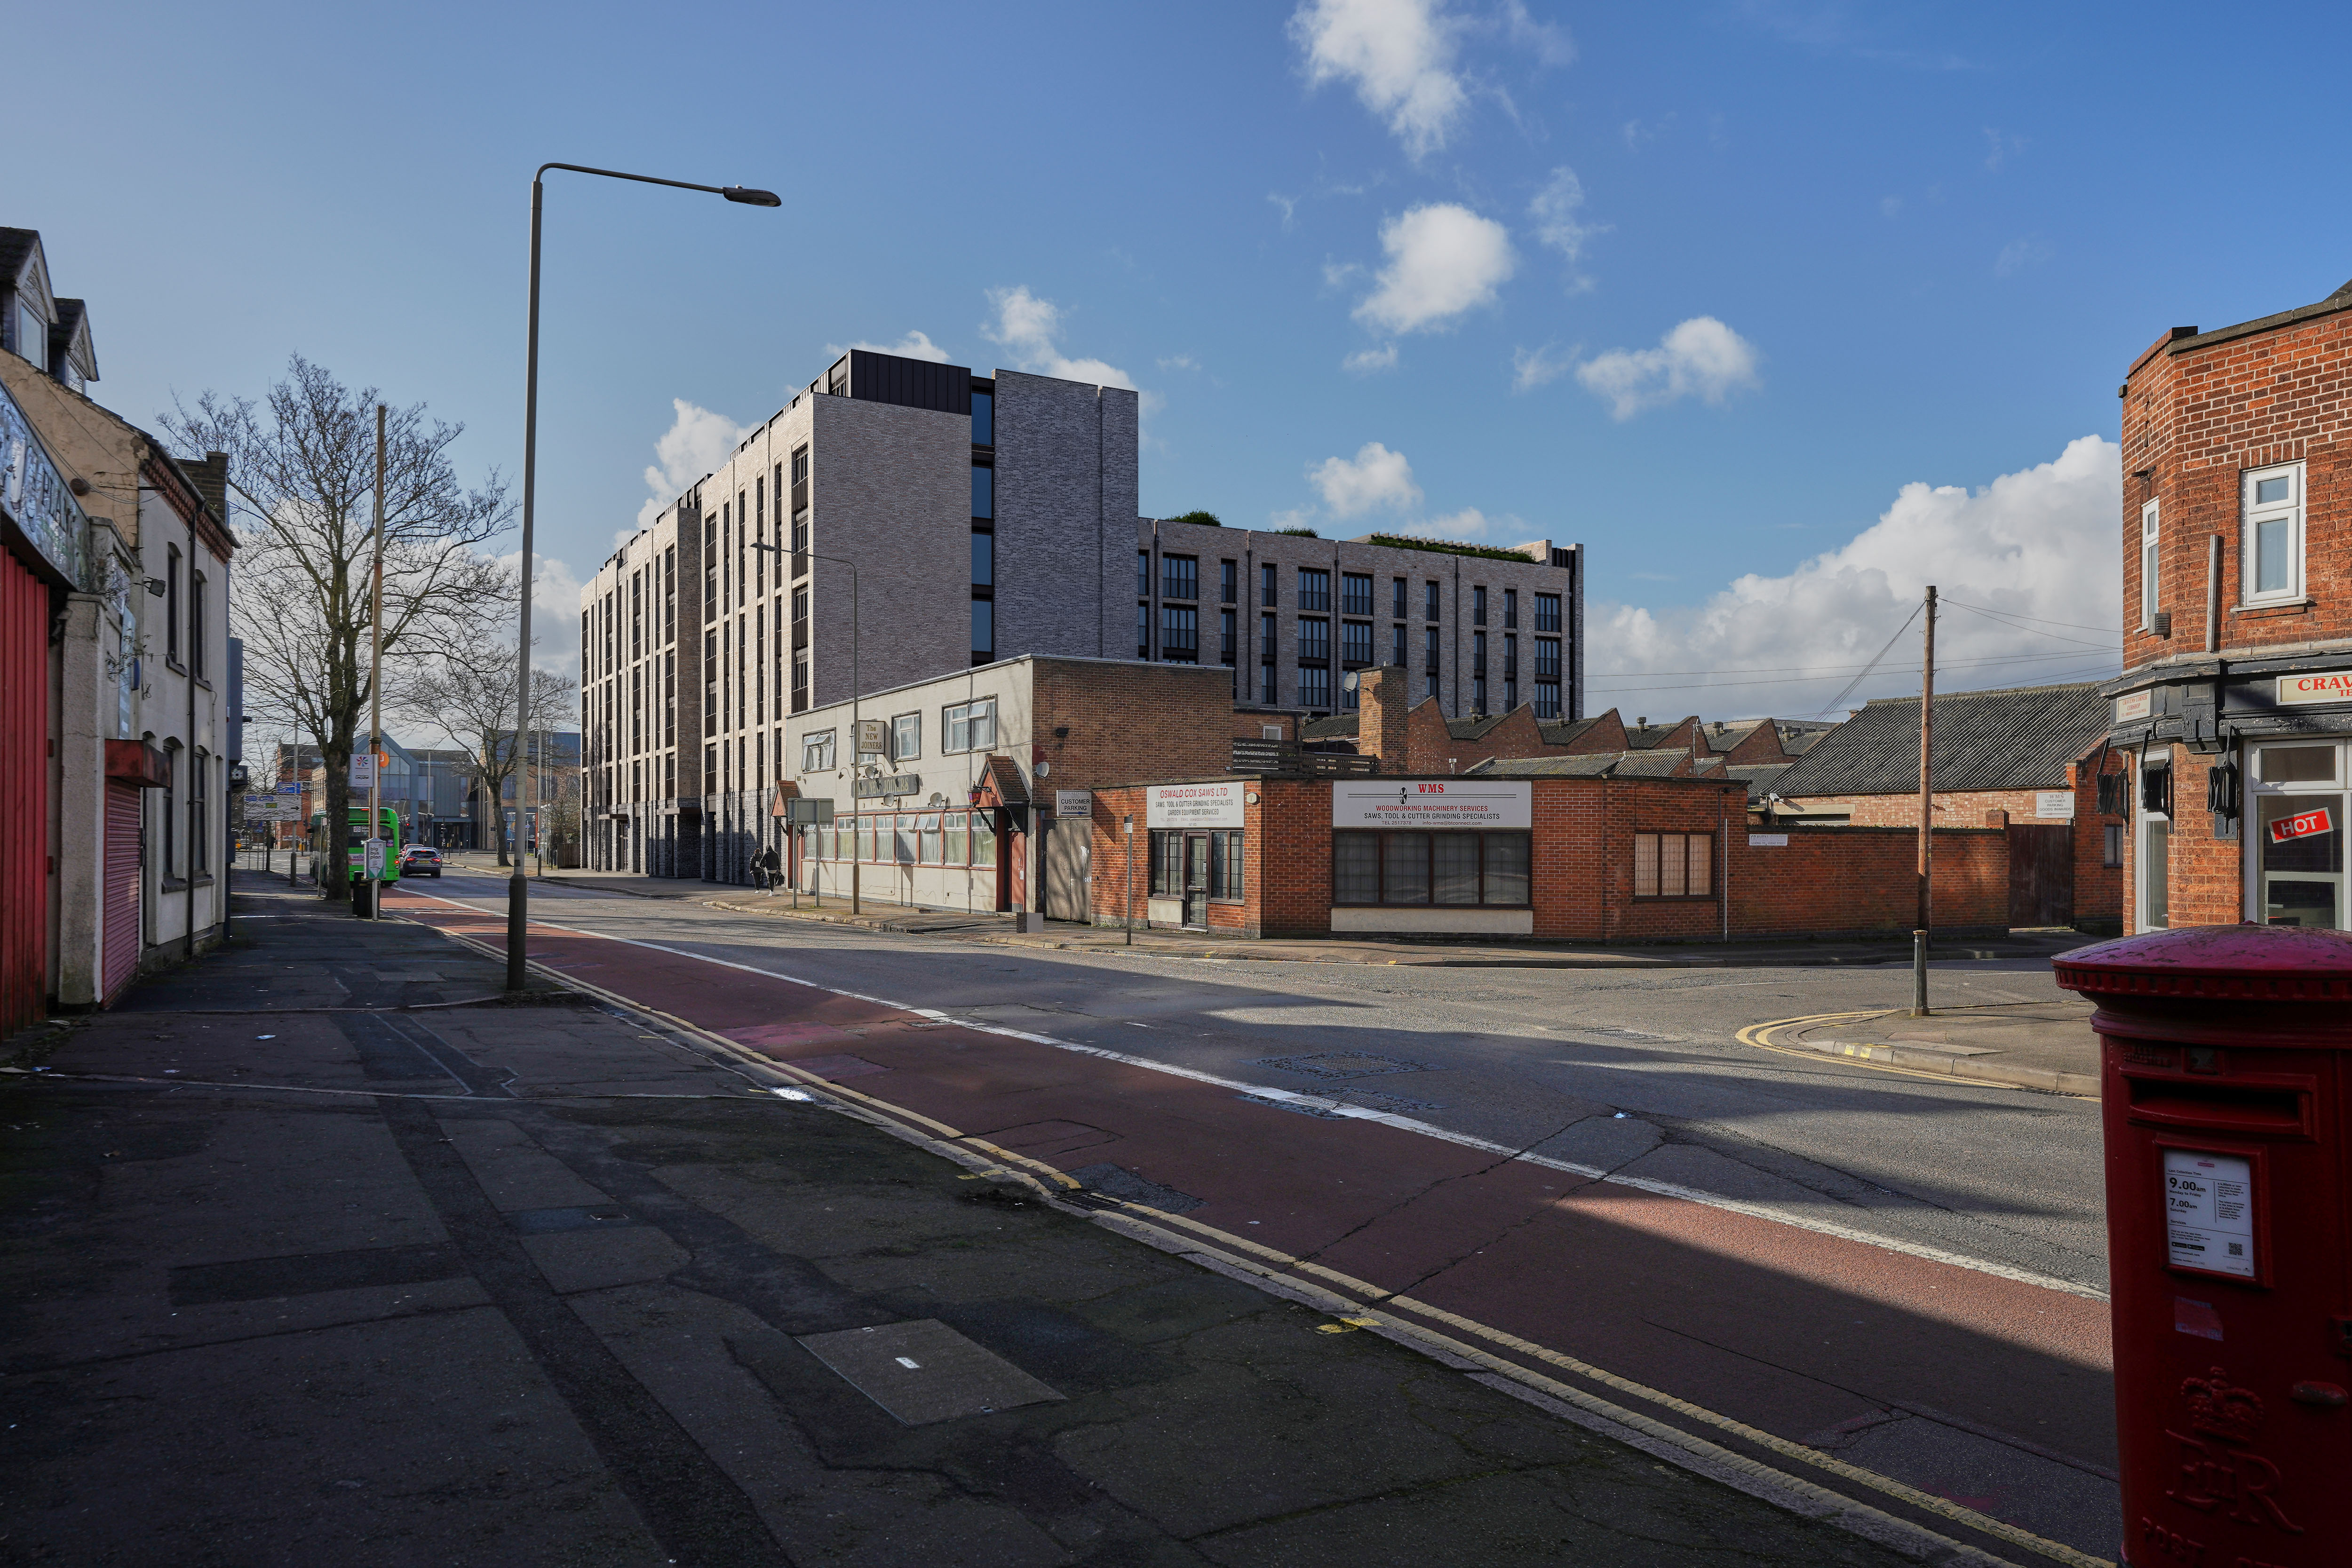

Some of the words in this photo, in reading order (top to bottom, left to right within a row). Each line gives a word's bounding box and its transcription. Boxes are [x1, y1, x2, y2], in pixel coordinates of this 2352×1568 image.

[1160, 789, 1183, 798] OSWALD
[1199, 788, 1215, 797] SAWS
[1216, 787, 1228, 796] LTD
[1418, 784, 1444, 793] WMS
[2280, 816, 2317, 836] HOT
[2169, 1177, 2206, 1192] 9.00am
[2169, 1197, 2197, 1209] 7.00am
